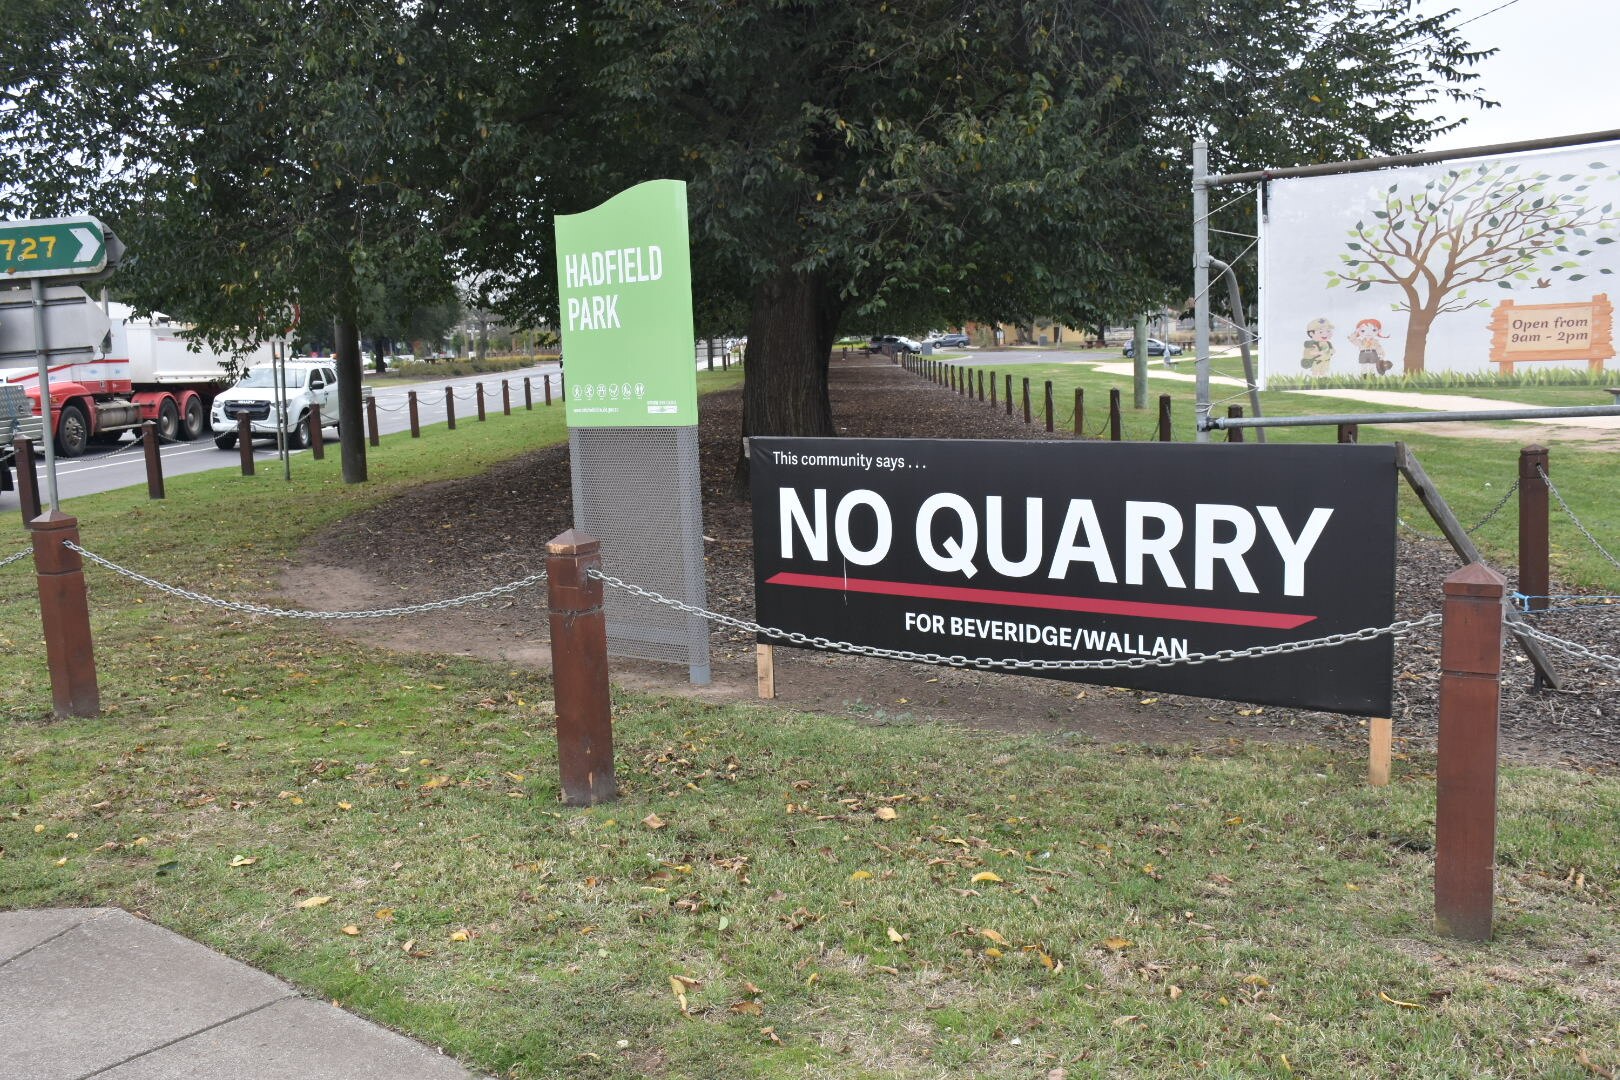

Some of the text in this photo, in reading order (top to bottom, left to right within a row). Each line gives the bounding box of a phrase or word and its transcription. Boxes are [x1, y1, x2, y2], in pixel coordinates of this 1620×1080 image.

[565, 246, 663, 289] HADFIELD
[567, 295, 621, 332] PARK
[1512, 317, 1588, 332] Open from
[1511, 333, 1541, 343] 9am
[1557, 332, 1588, 344] 2pm
[773, 451, 798, 466] This
[801, 452, 873, 471] community
[780, 487, 1335, 597] NO QUARRY
[905, 612, 1189, 660] FOR BEVERIDGE/WALLAN
